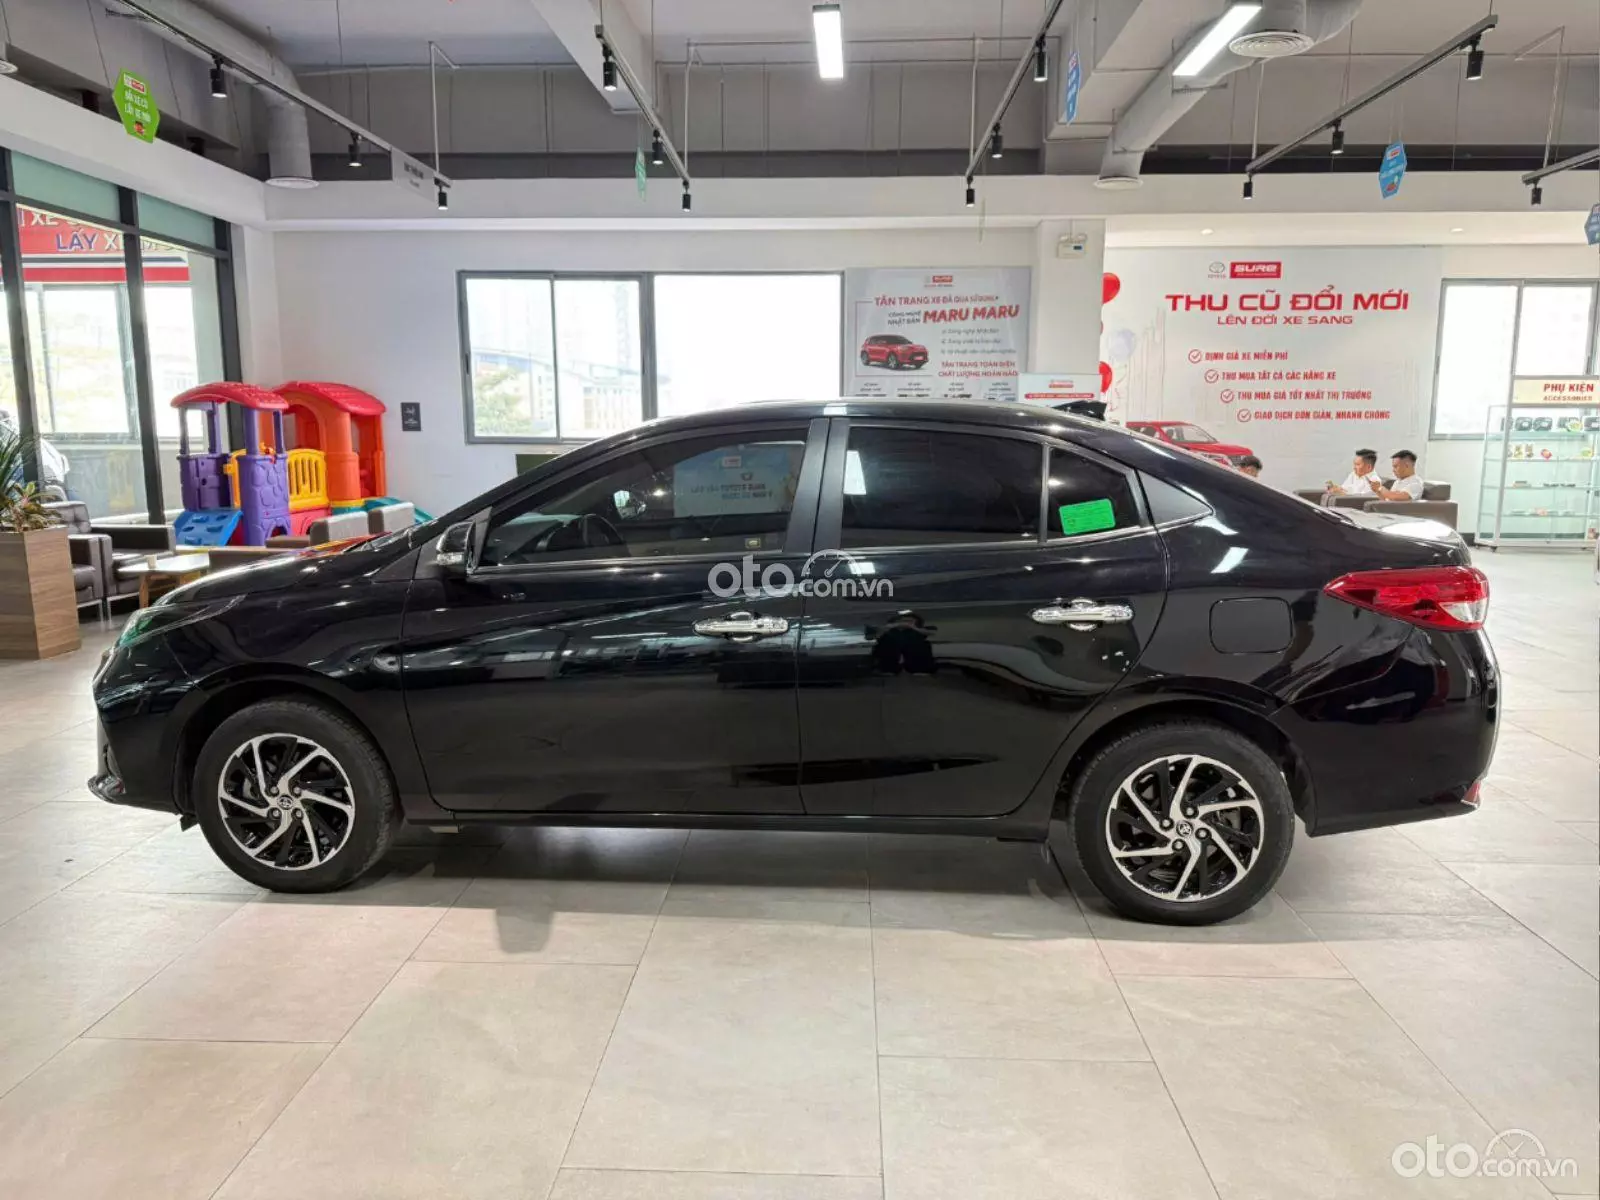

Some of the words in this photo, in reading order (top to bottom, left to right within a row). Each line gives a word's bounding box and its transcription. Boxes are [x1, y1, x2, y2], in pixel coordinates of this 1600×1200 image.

[55, 227, 98, 251] LẤY
[104, 234, 125, 251] X
[898, 296, 930, 306] TRANG
[1165, 294, 1229, 312] THU
[1239, 289, 1281, 311] CŨ
[1289, 284, 1343, 311] ĐỔI
[1353, 289, 1409, 310] MỚI
[922, 308, 969, 324] MARU
[972, 304, 1020, 321] MARU
[1217, 314, 1247, 325] LÊN
[1283, 315, 1303, 325] XE
[1308, 315, 1354, 325] SANG
[1242, 352, 1251, 361] XE
[1222, 371, 1237, 380] THU
[1239, 371, 1255, 380] MUA
[1327, 371, 1336, 380] XE
[1543, 383, 1566, 394] PHỤ
[1568, 381, 1594, 394] KIỆN
[1237, 391, 1252, 400] THU
[1254, 391, 1271, 400] MUA
[1254, 411, 1272, 420] GIAO
[1335, 411, 1362, 420] NHANH
